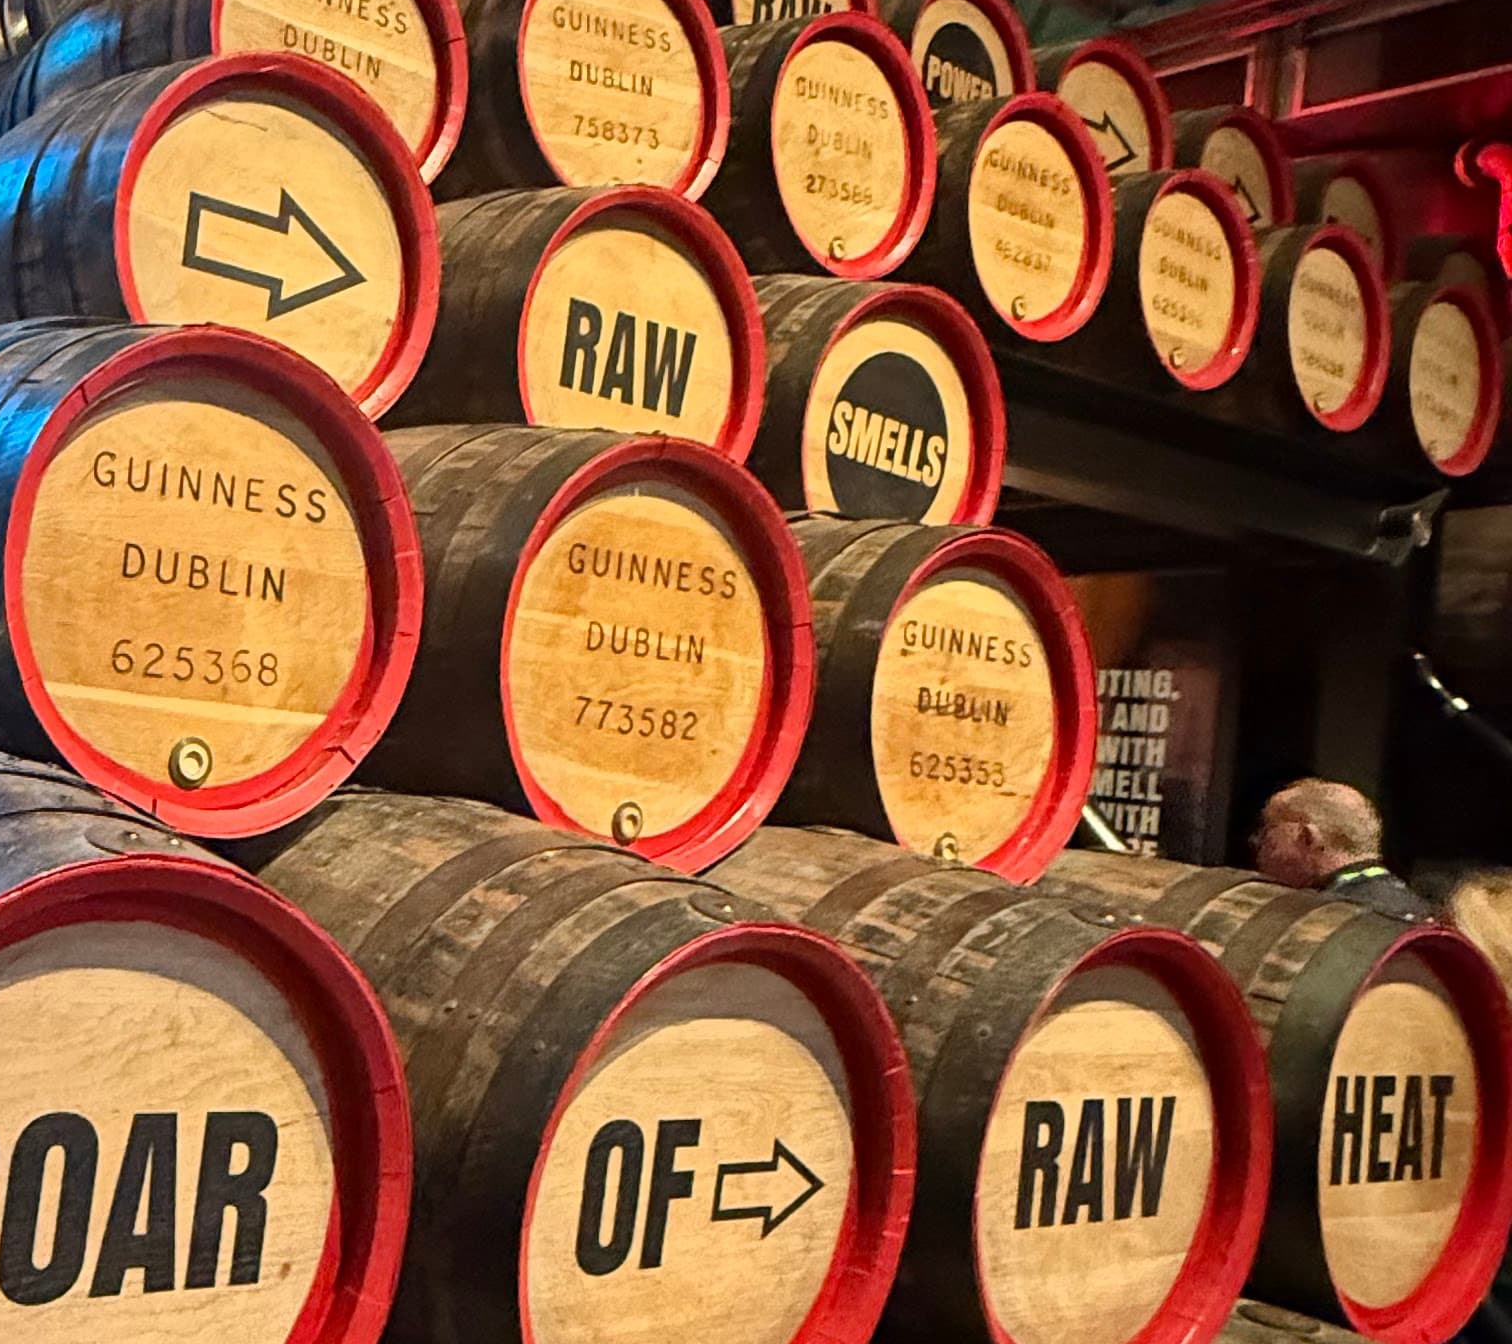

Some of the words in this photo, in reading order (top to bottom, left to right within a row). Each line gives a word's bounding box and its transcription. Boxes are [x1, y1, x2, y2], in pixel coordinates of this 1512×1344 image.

[283, 23, 382, 79] DUBLIN
[552, 5, 672, 53] GUINNESS
[569, 59, 654, 97] DUBLIN
[795, 75, 889, 120] GUINNESS
[573, 114, 660, 150] 758373
[806, 122, 873, 161] DUBLIN
[988, 148, 1072, 196] GUINNESS
[996, 192, 1055, 229] DUBLIN
[559, 297, 697, 418] RAW
[827, 400, 947, 489] SMELLS
[92, 450, 329, 523] GUINNESS
[121, 542, 288, 604] DUBLIN
[567, 541, 738, 601] GUINNESS
[110, 638, 281, 688] 625368
[586, 620, 707, 665] DUBLIN
[903, 620, 1032, 668] GUINNESS
[573, 696, 701, 742] 773582
[917, 686, 1010, 727] DUBLIN
[1111, 703, 1169, 733] AND
[909, 751, 1005, 788] 625353
[1089, 768, 1163, 801] MELL
[1330, 1074, 1455, 1187] HEAT
[1014, 1095, 1176, 1230] RAW
[574, 1118, 702, 1276] OF
